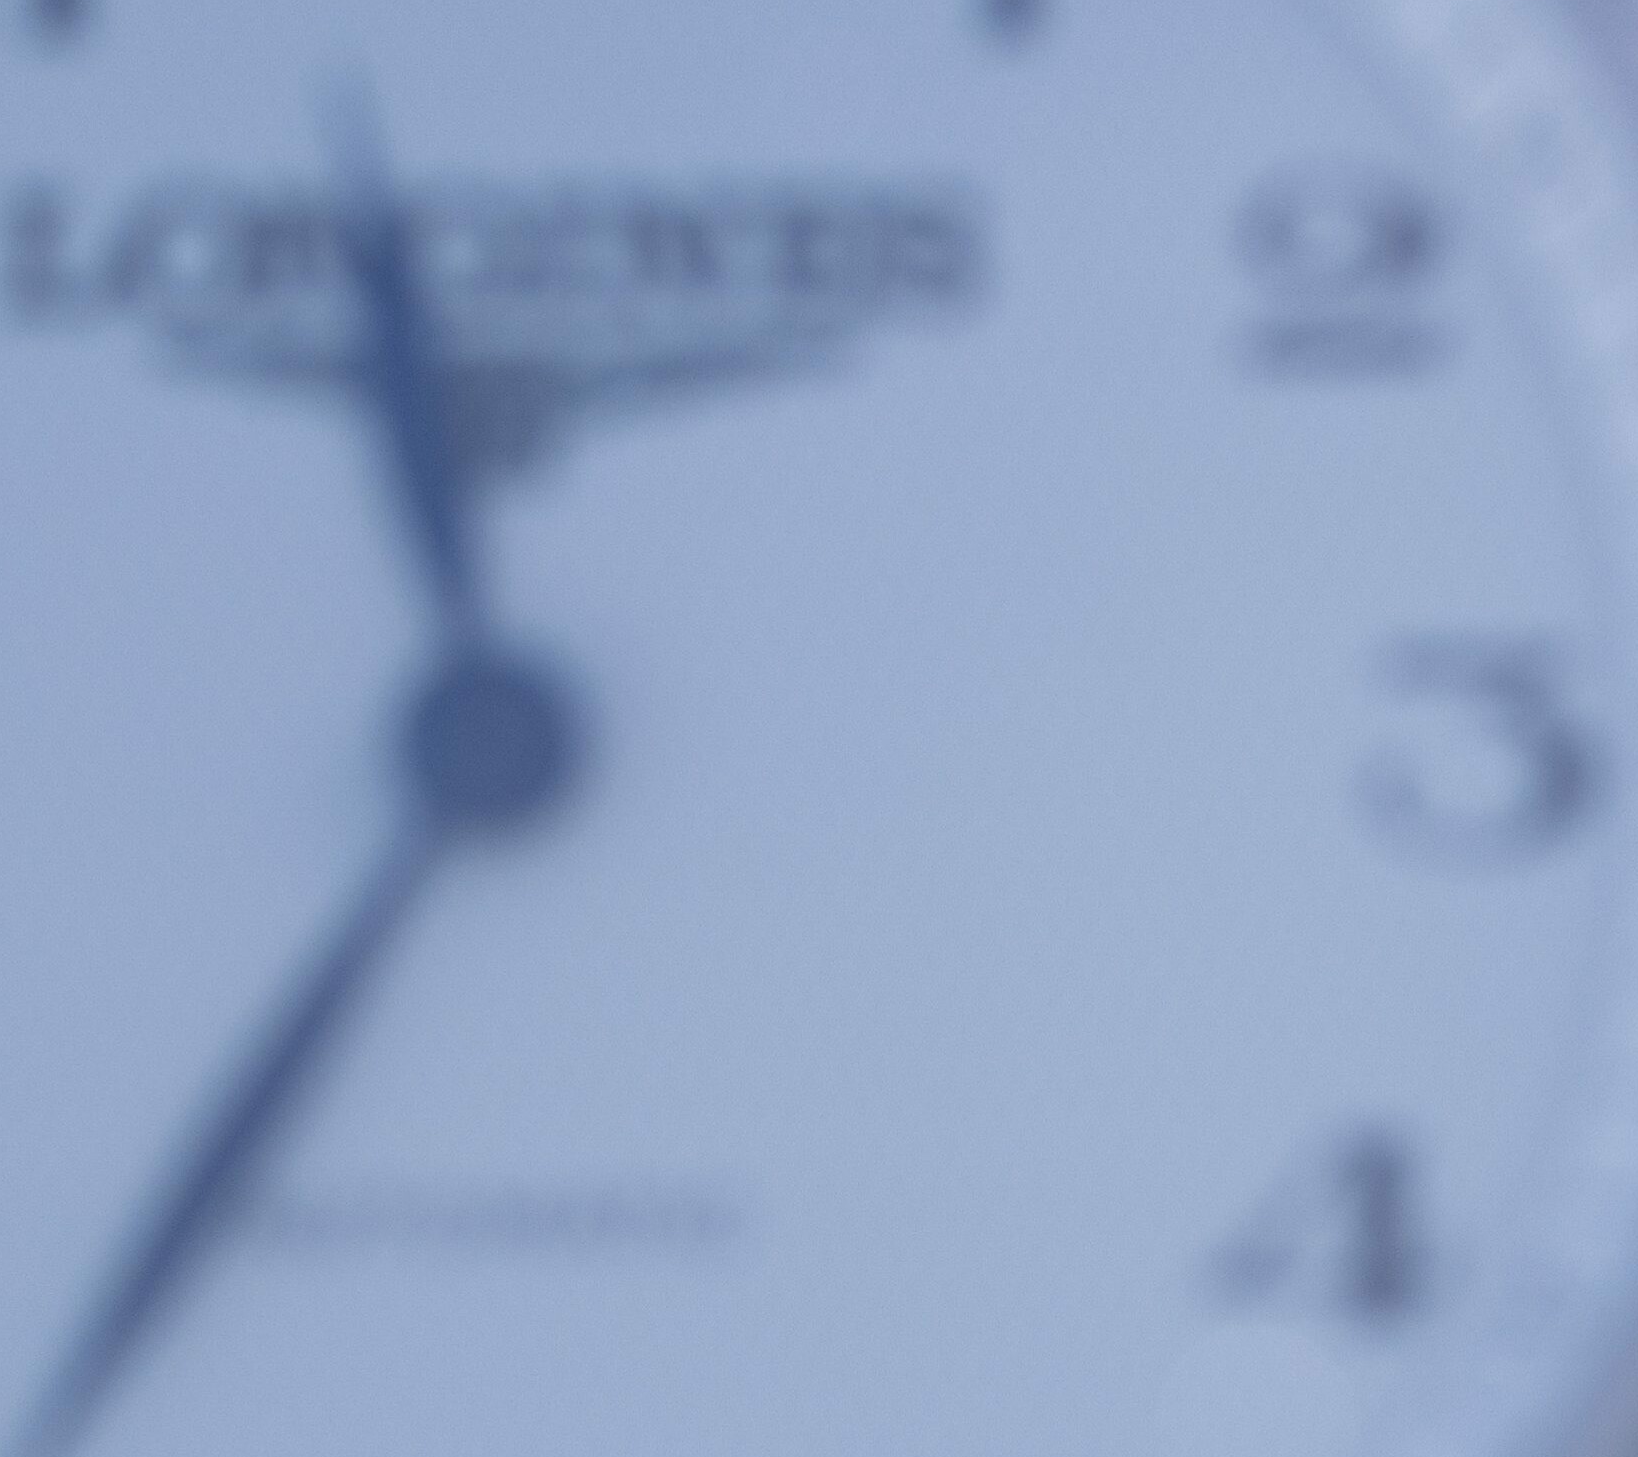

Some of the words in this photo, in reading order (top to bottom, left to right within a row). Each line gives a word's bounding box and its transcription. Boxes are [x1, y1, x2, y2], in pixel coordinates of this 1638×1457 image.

[1235, 172, 1446, 378] 2
[1362, 631, 1601, 856] 3
[1200, 1124, 1428, 1316] 4
